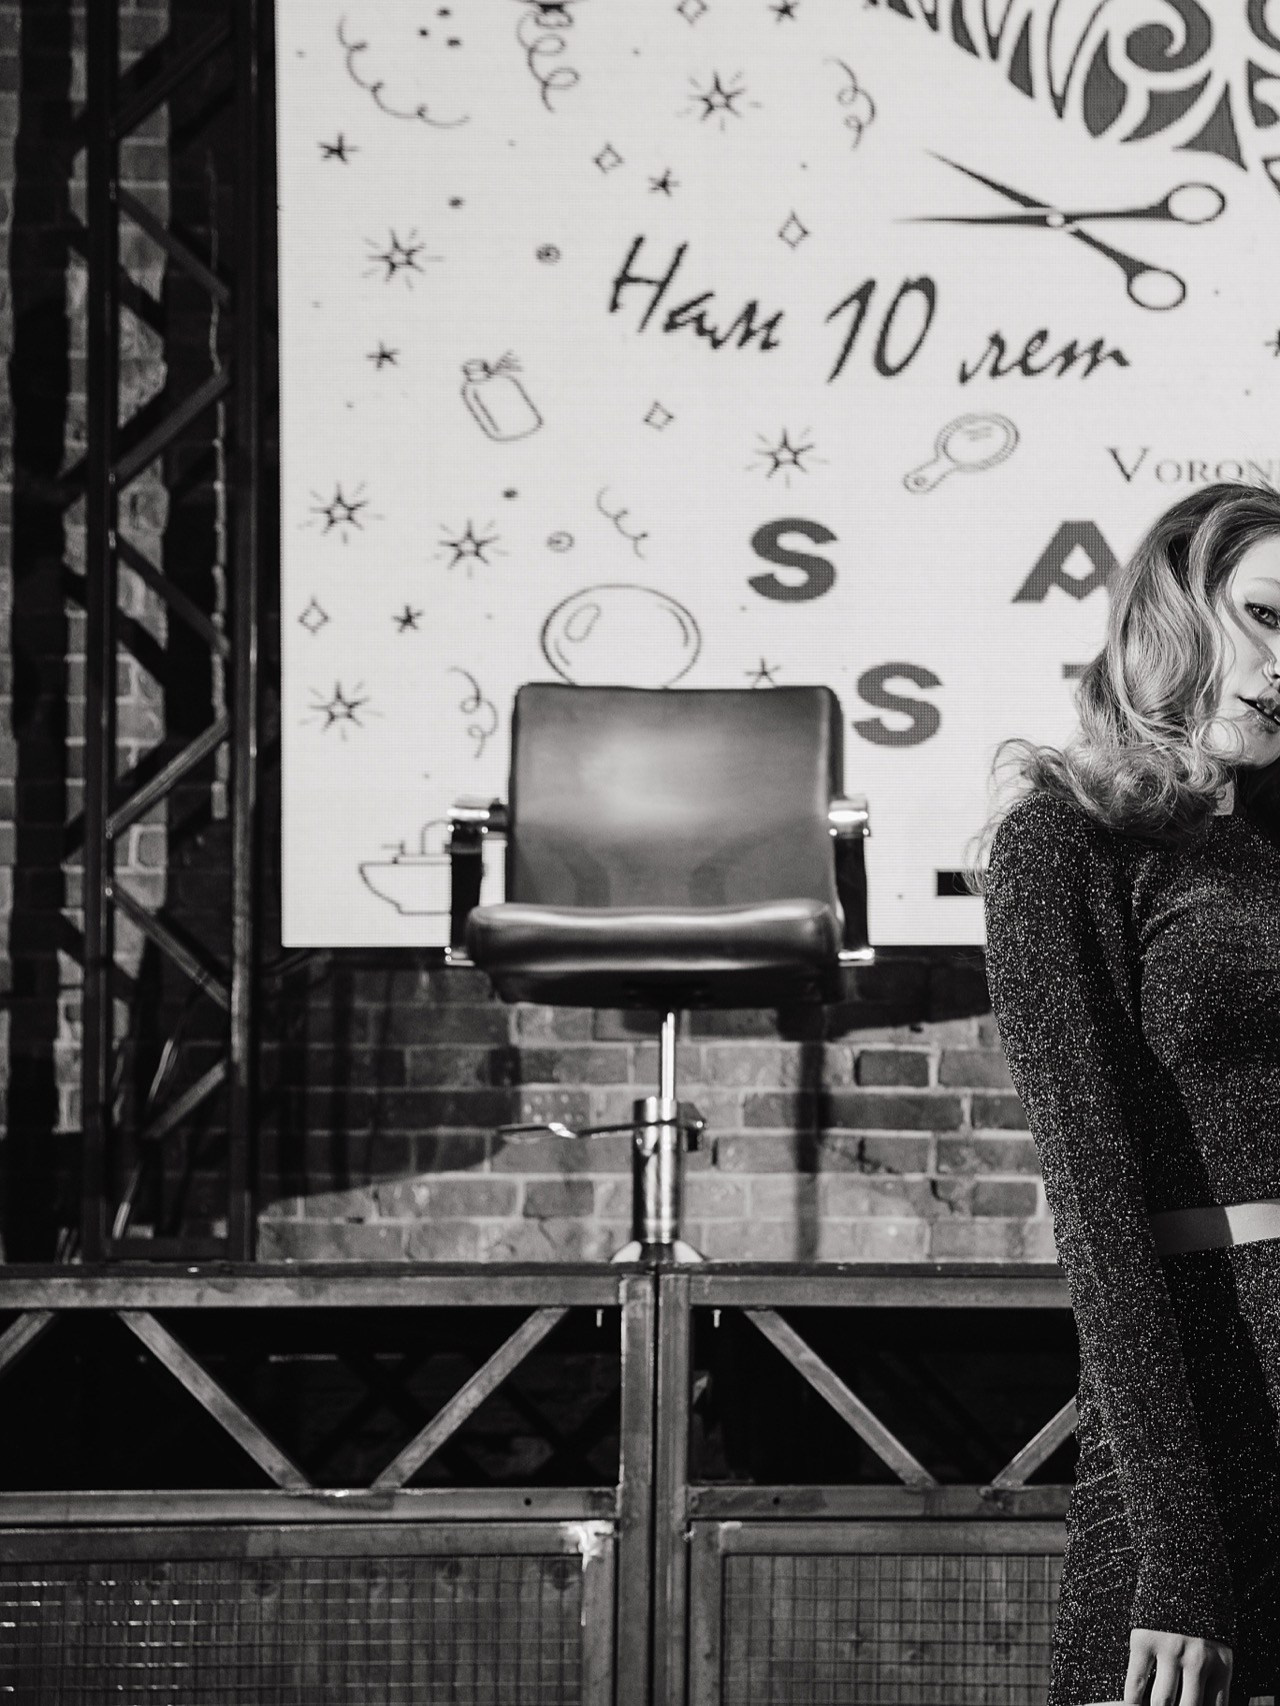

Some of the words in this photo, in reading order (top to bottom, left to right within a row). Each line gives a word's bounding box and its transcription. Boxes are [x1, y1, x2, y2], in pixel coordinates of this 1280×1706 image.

[607, 234, 784, 351] Нам
[824, 274, 938, 385] 10
[957, 327, 1131, 387] лет
